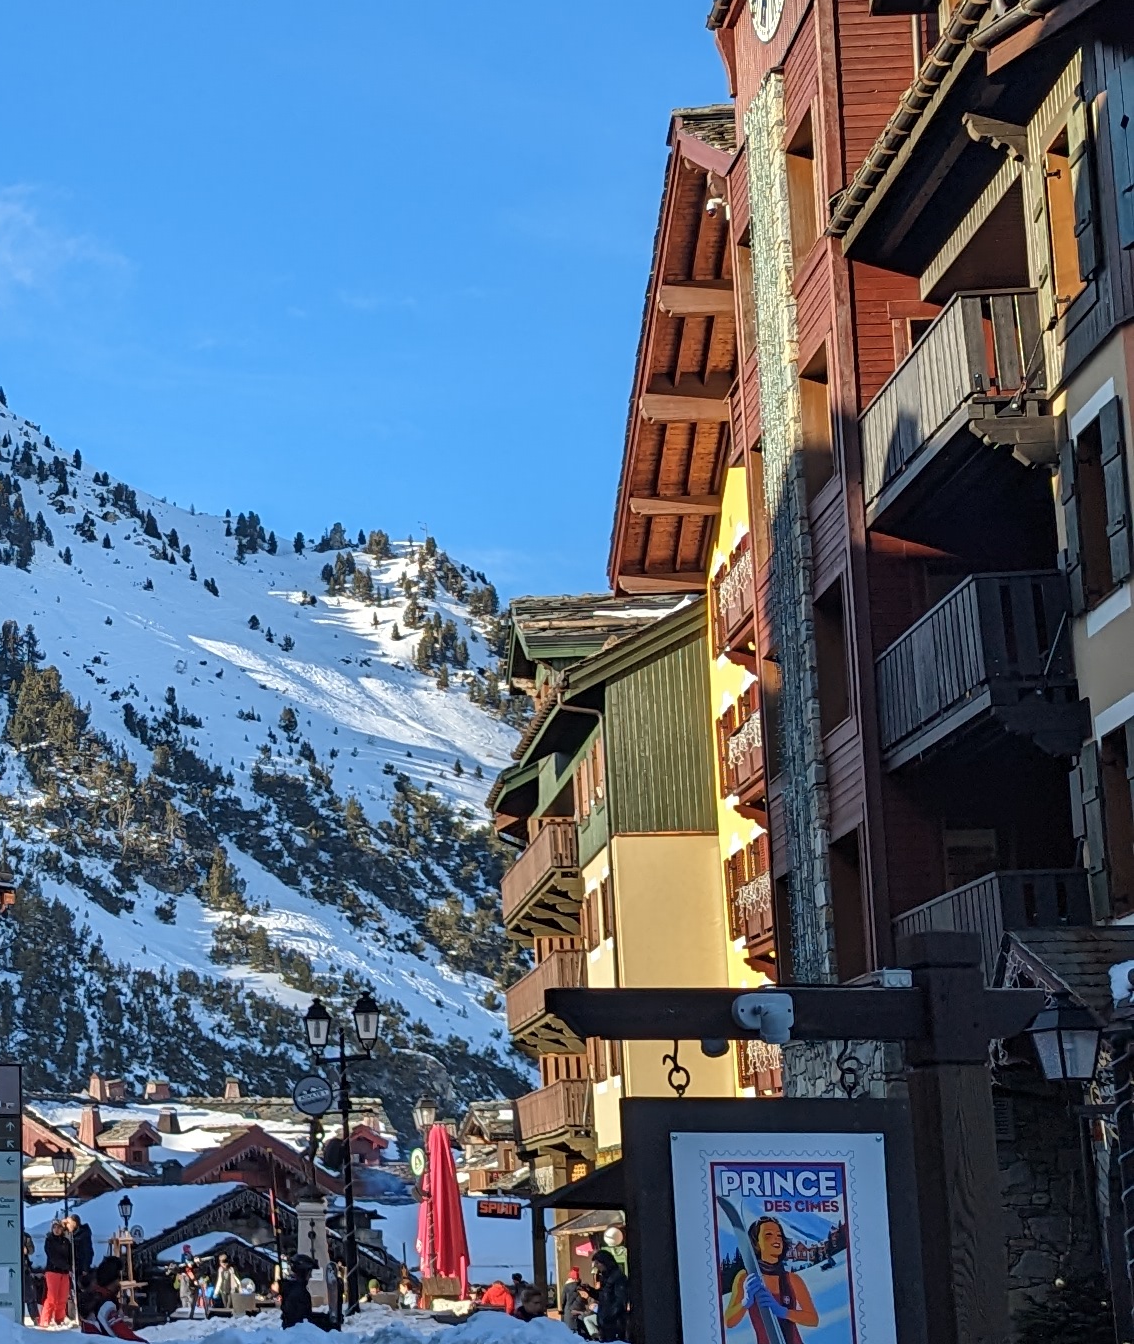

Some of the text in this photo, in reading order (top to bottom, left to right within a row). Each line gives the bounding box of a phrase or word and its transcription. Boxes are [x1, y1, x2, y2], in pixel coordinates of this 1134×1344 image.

[720, 1170, 837, 1197] PRINCE
[479, 1201, 520, 1216] SPIRIT
[764, 1200, 840, 1213] DES CIMES
